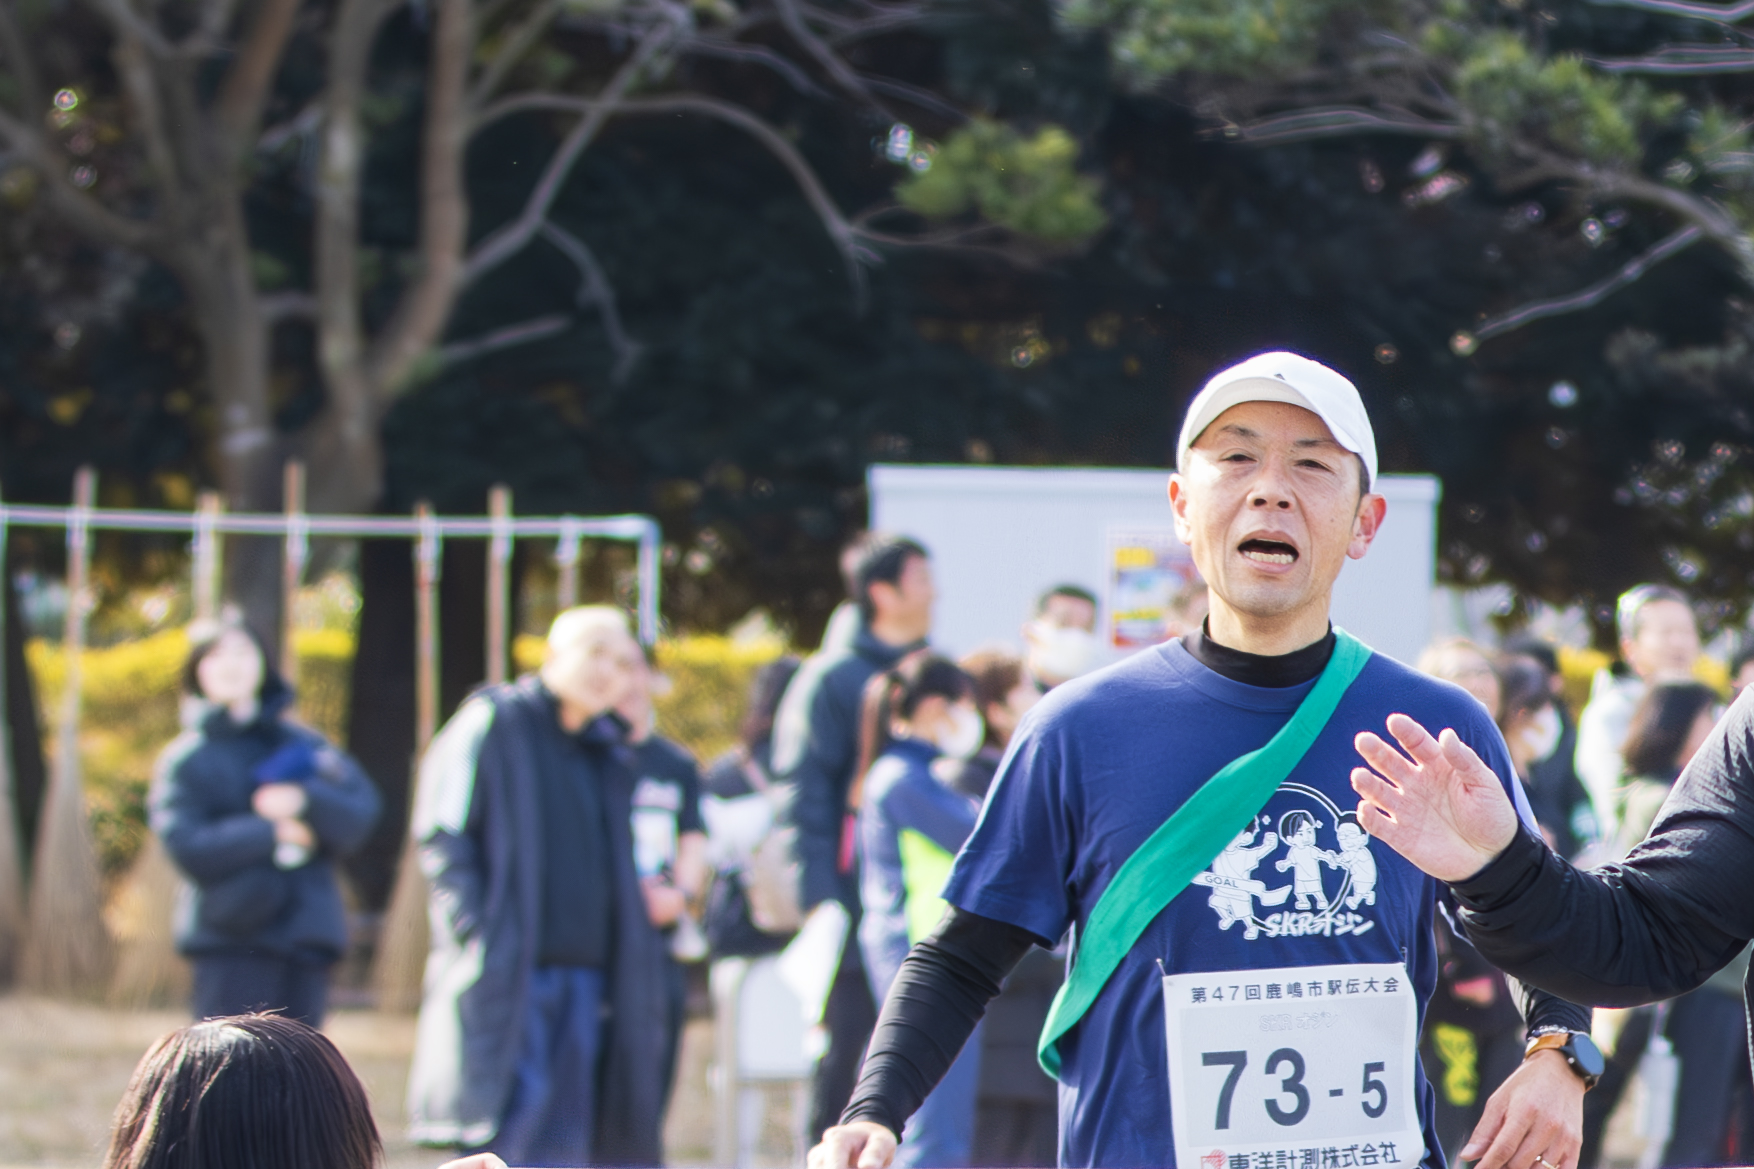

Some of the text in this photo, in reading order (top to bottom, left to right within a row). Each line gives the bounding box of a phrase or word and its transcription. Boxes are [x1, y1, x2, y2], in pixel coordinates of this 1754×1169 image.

[1204, 874, 1239, 889] GOAL
[1190, 976, 1399, 1005] 第47回鹿嶋市駅伝大会
